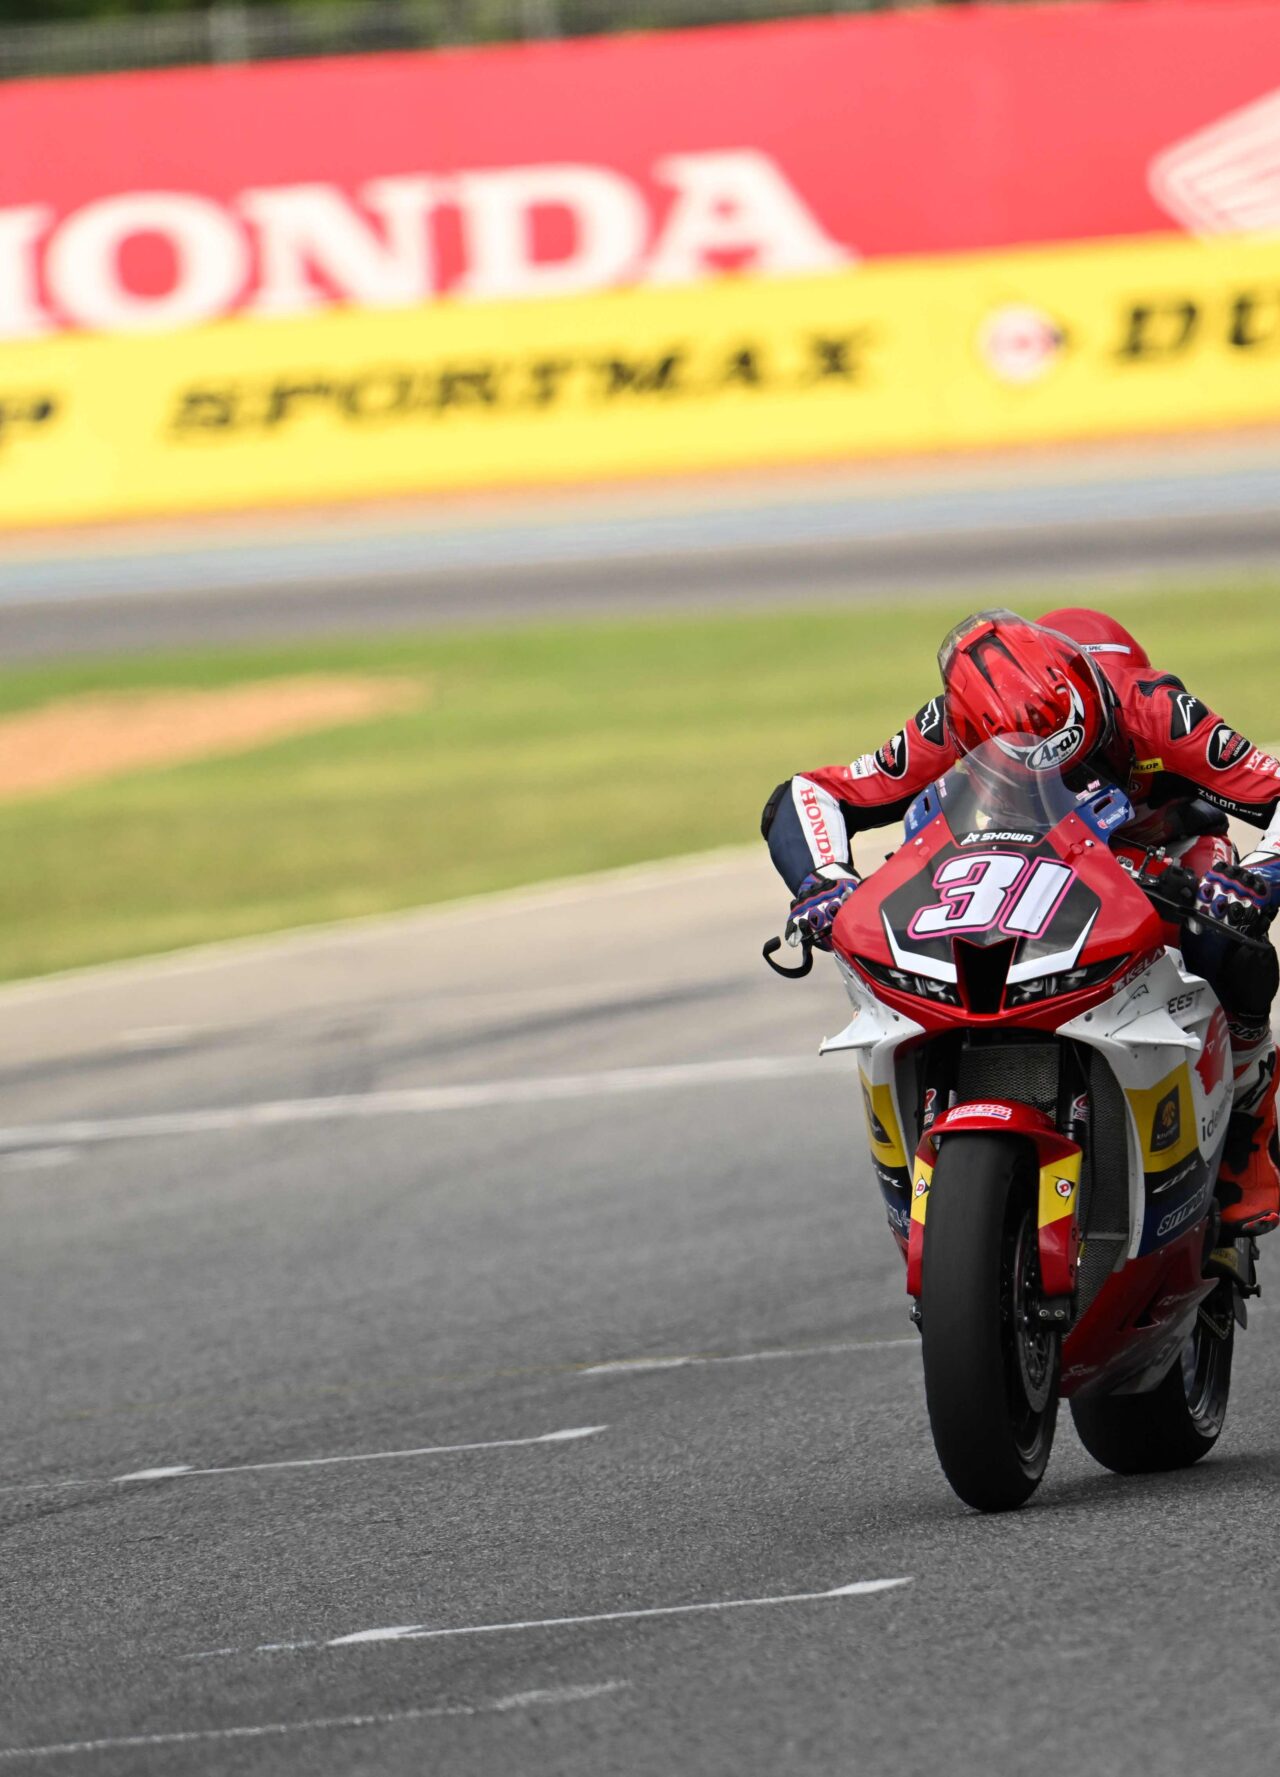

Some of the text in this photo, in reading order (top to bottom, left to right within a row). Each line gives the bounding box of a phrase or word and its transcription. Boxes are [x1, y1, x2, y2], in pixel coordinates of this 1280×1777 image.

[0, 146, 860, 338] ONDA
[170, 330, 870, 436] SPORTMAX
[1038, 728, 1078, 766] Arai
[801, 787, 836, 866] HONDA
[980, 832, 1035, 843] SHOWA
[907, 850, 1078, 940] 31
